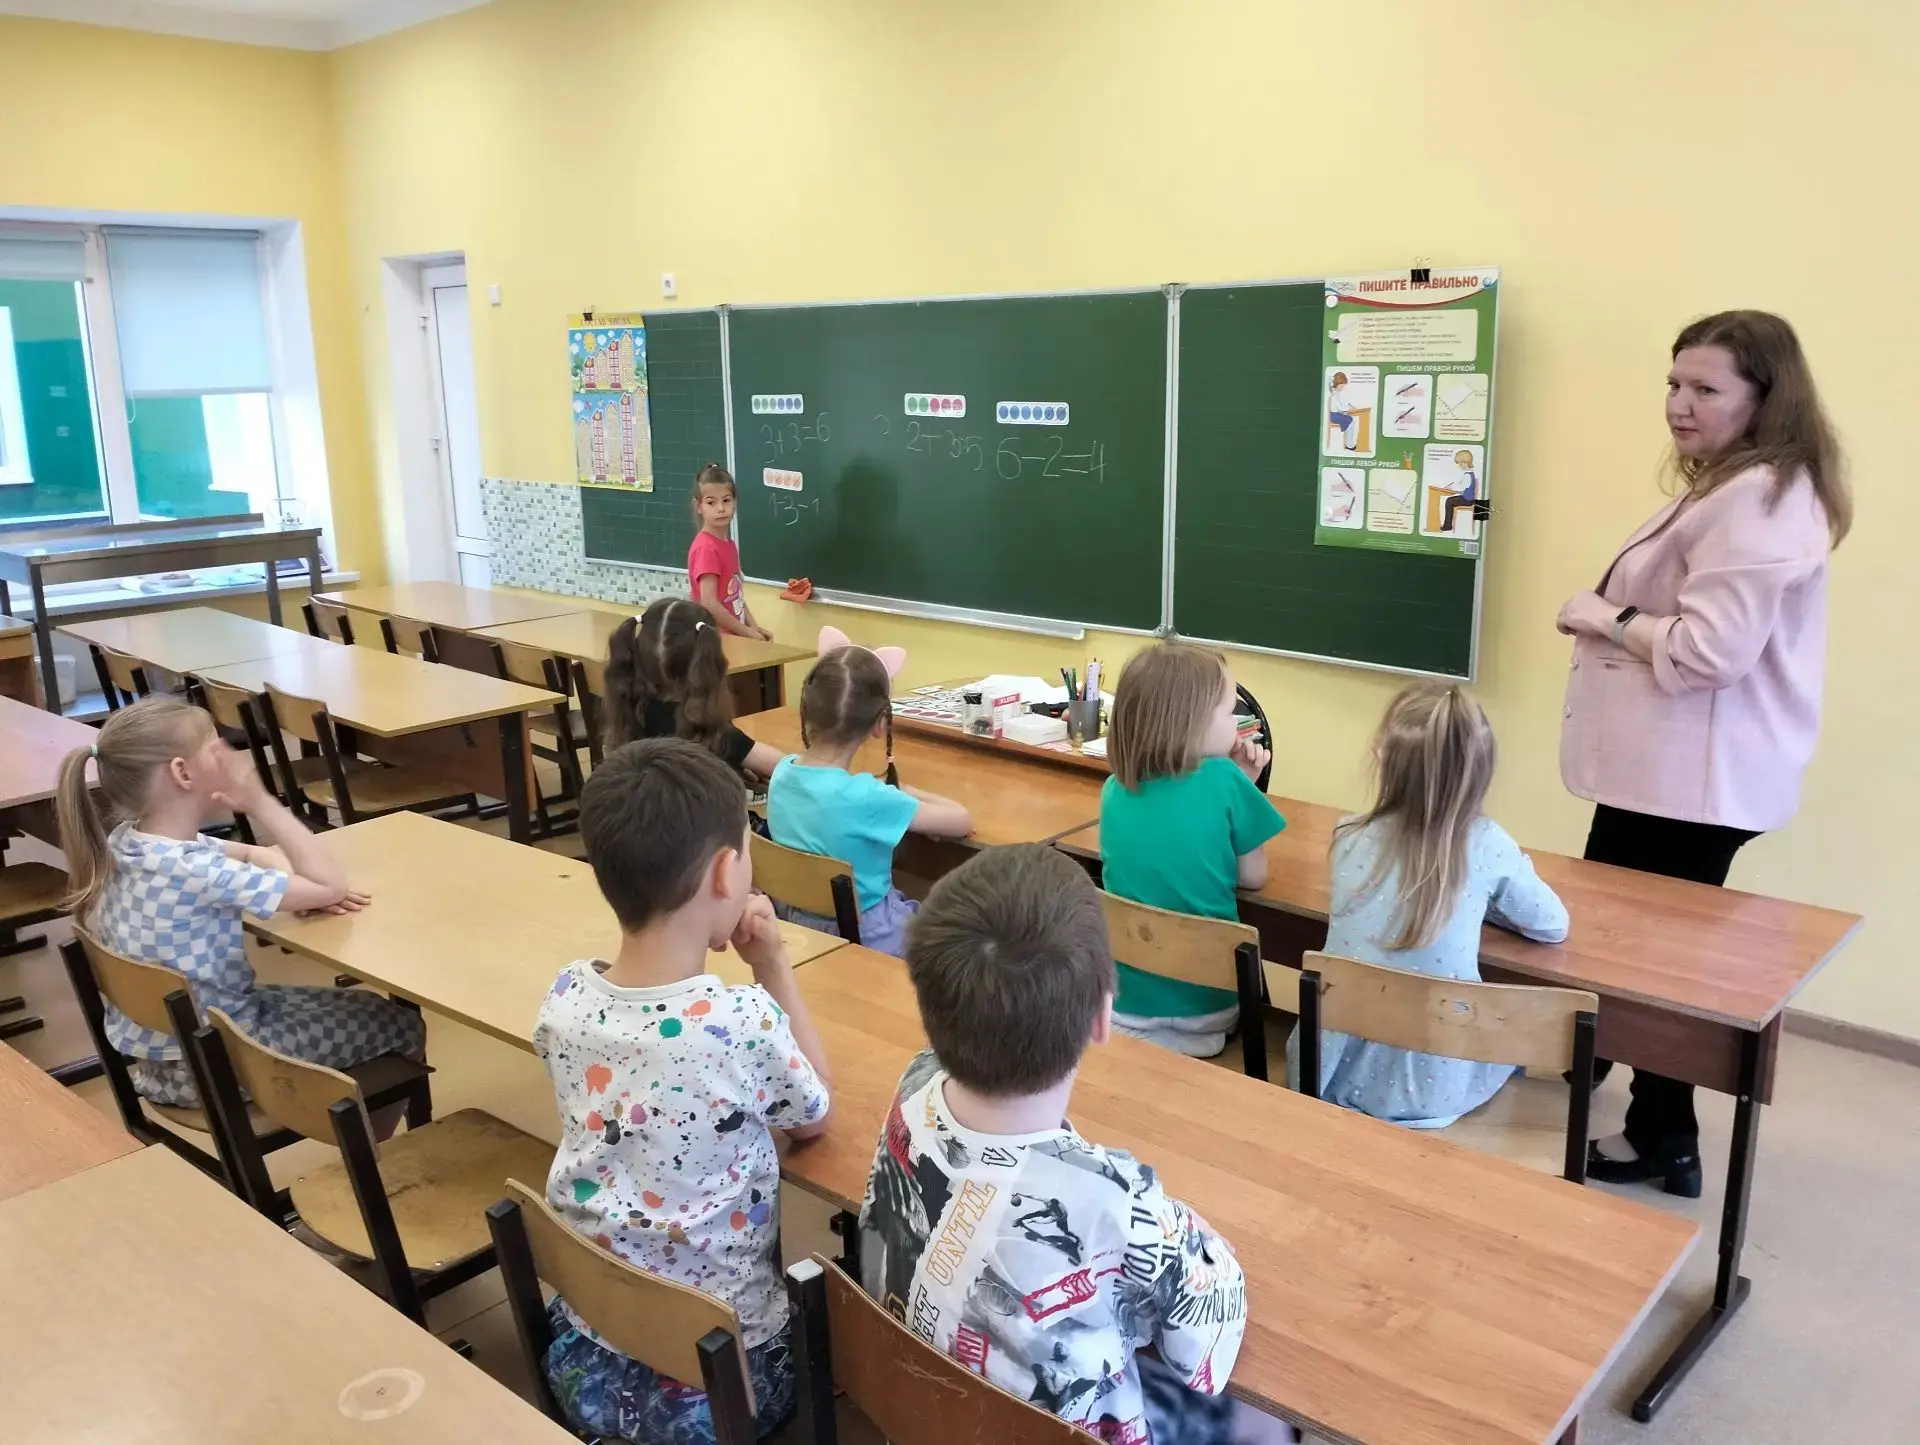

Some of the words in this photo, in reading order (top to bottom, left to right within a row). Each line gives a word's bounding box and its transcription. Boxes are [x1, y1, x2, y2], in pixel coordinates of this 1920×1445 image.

[1359, 279, 1407, 293] ПИШИТЕ
[1410, 275, 1479, 290] ПРАВИЛЬНО
[1423, 364, 1452, 372] ПРАВОЙ
[1452, 363, 1476, 371] РУКОЙ
[1330, 458, 1355, 466] ПИШЕМ
[1355, 458, 1377, 467] ЛЕВОЙ
[1378, 459, 1401, 468] РУКОЙ
[925, 1178, 997, 1287] UNTIL
